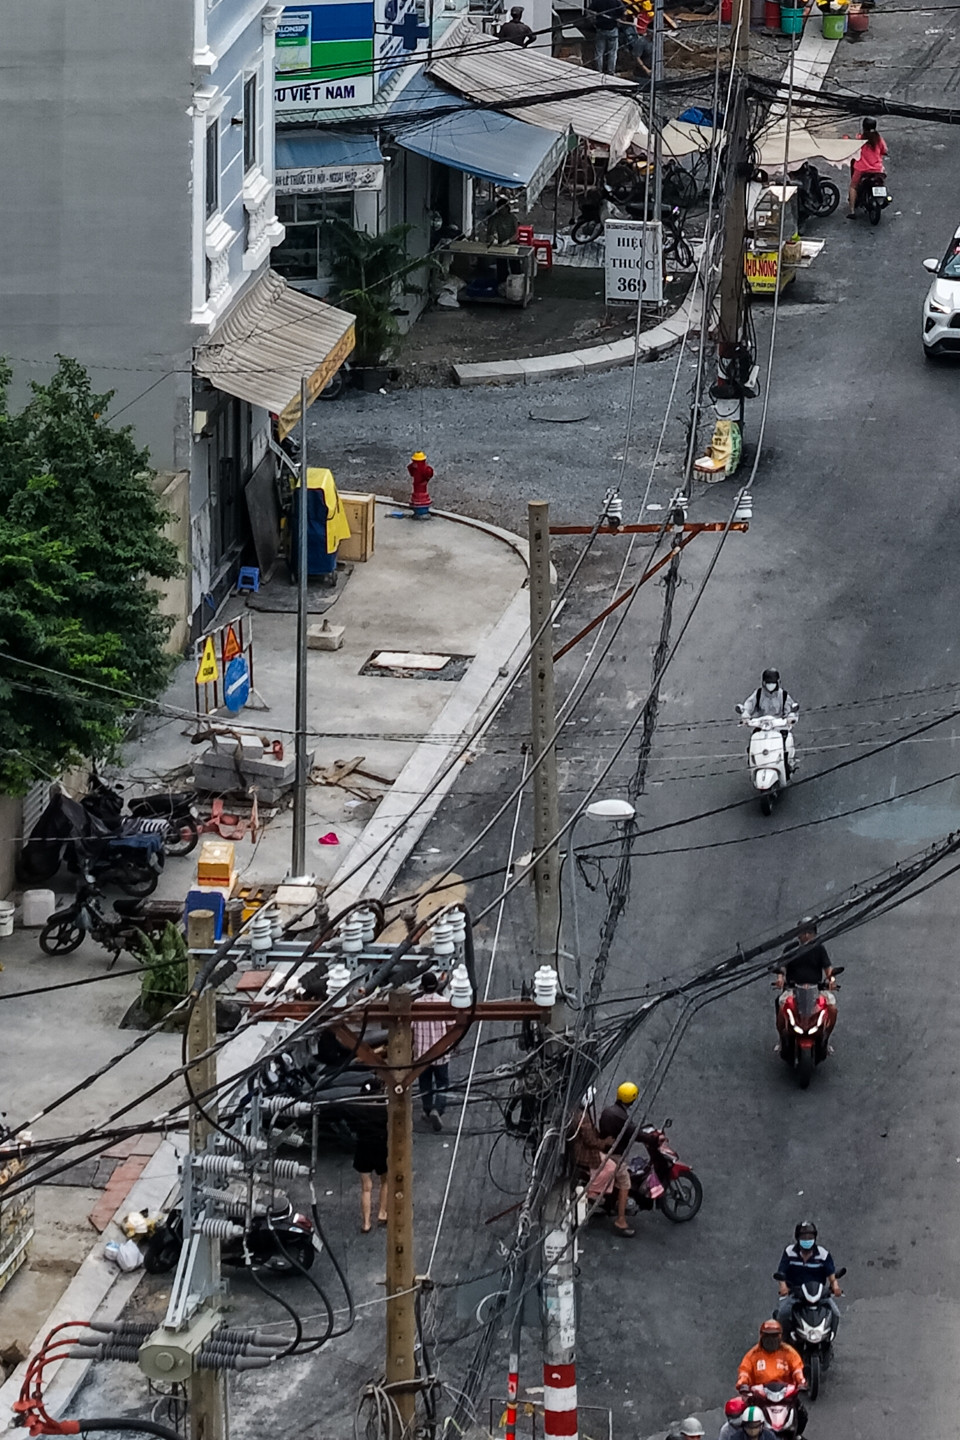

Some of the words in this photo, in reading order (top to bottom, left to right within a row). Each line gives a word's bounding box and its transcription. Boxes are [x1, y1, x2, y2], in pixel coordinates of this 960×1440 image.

[290, 86, 321, 104] VIỆT
[326, 85, 355, 100] NAM
[617, 277, 647, 293] 369
